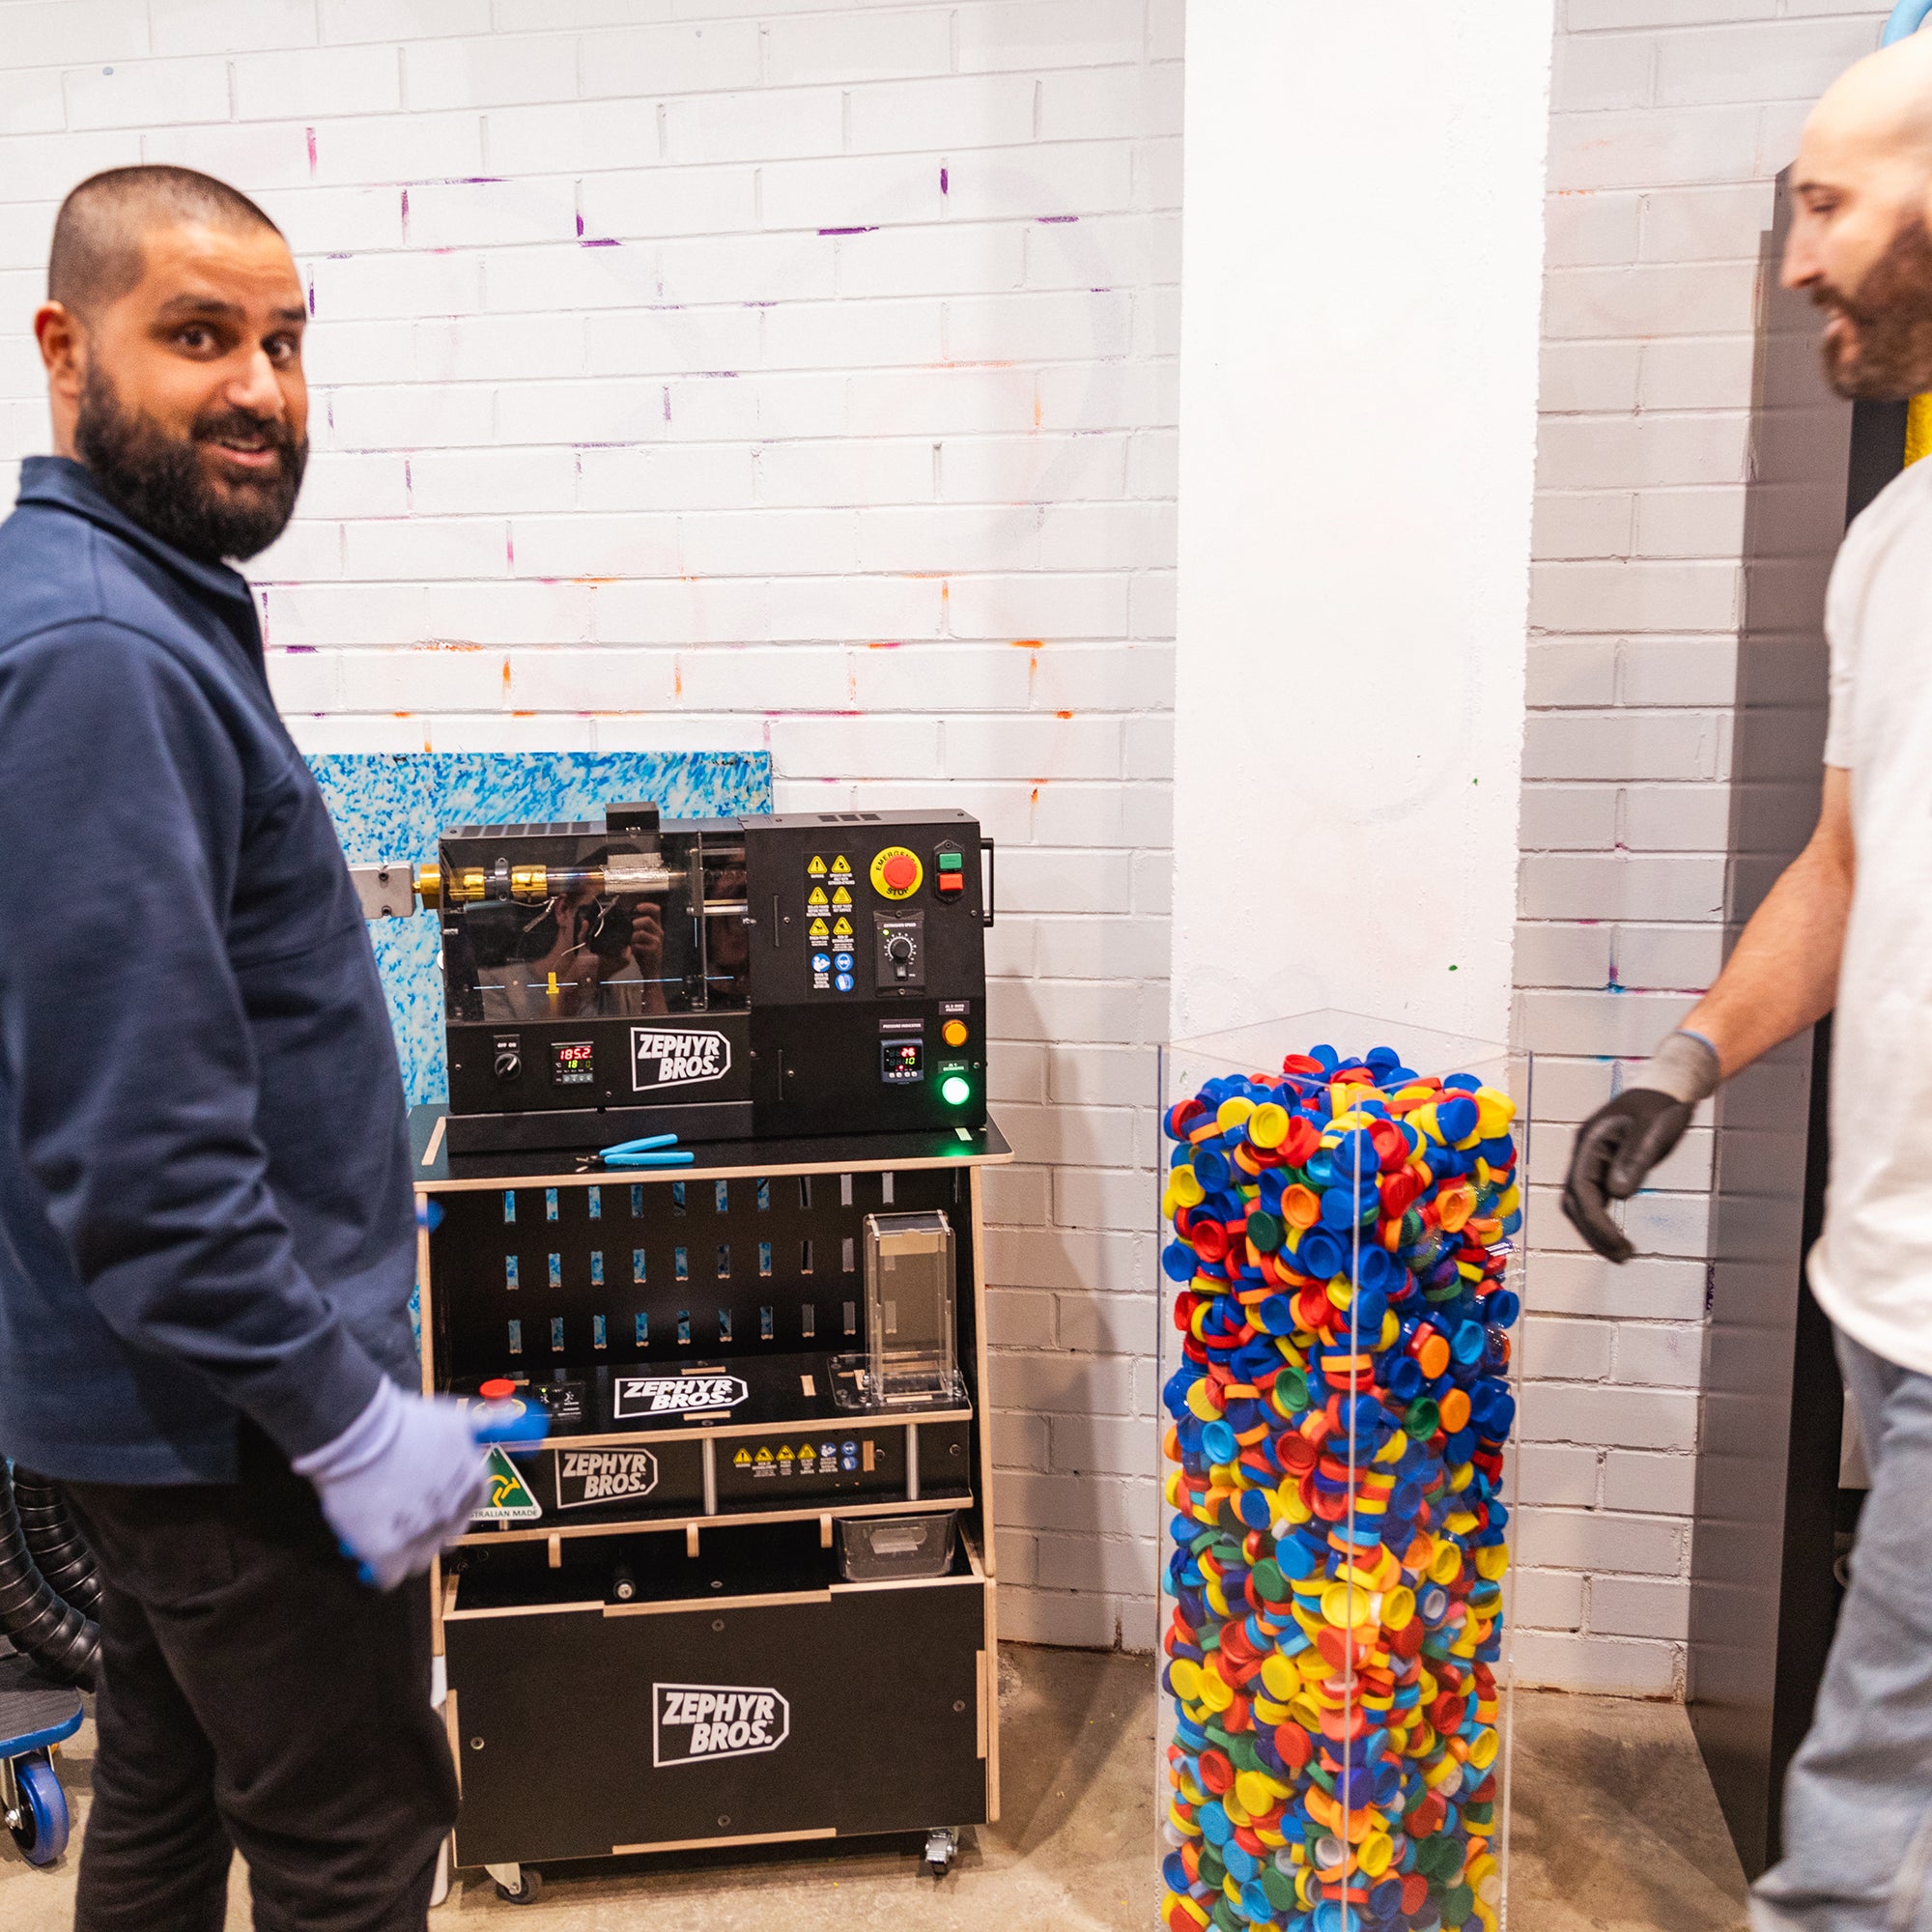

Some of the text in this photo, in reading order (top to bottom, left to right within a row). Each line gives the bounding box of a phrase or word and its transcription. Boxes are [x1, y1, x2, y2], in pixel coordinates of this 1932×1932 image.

[875, 850, 919, 871] EMERGE
[886, 887, 909, 896] STOP
[638, 1034, 720, 1060] ZEPHYR
[900, 1047, 916, 1058] 26
[658, 1055, 720, 1082] BROS.
[905, 1057, 916, 1065] 10
[623, 1379, 733, 1399] ZEPHYR
[650, 1391, 732, 1410] BROS.
[562, 1453, 647, 1478] ZEPHYR
[583, 1472, 646, 1499] BROS.
[512, 1509, 537, 1518] MADE
[662, 1691, 775, 1725] ZEPHYR
[689, 1719, 773, 1754] BROS.
